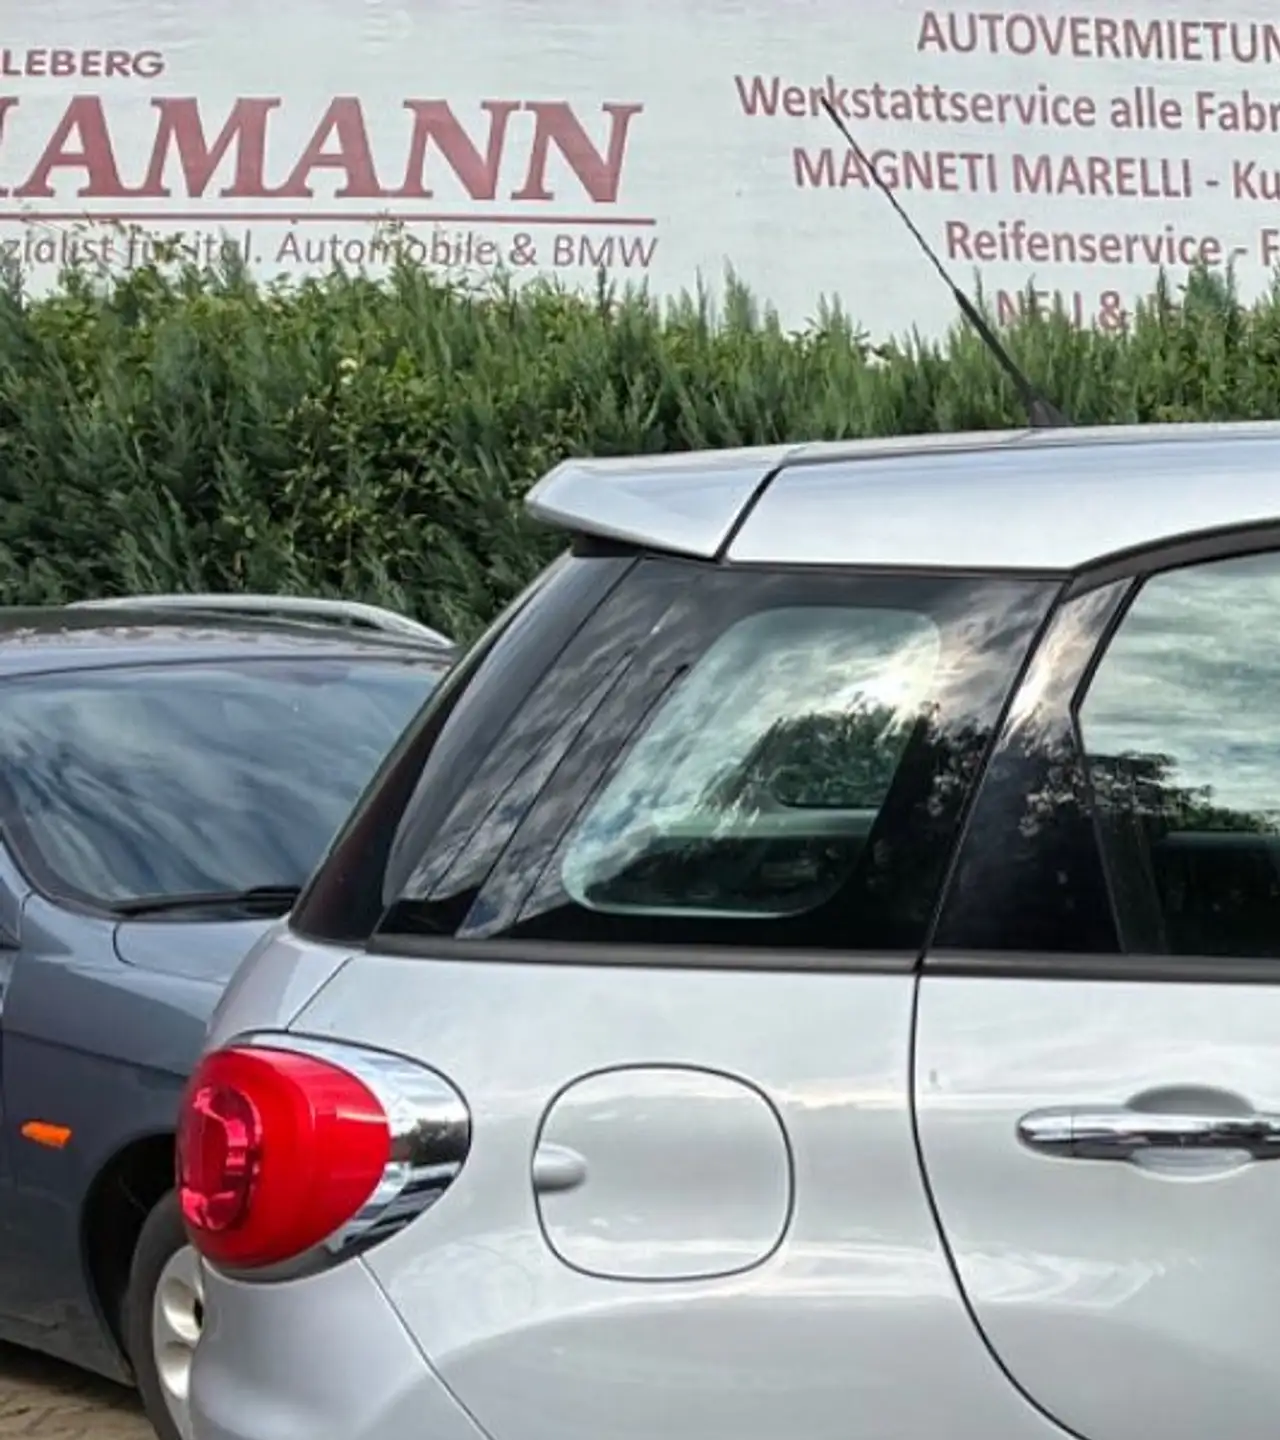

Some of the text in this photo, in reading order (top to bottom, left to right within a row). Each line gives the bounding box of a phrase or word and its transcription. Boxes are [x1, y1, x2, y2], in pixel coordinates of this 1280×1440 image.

[2, 49, 165, 78] LEBERG
[734, 75, 1096, 128] Werkstattservice
[1110, 86, 1183, 130] alle
[0, 95, 643, 203] AMANN
[793, 147, 997, 193] MAGNETI
[1012, 154, 1192, 198] MARELLI
[123, 224, 174, 270] fü
[275, 230, 496, 266] Automobile
[509, 231, 539, 267] &
[553, 233, 659, 269] BMW
[945, 220, 1222, 267] Reifenservice
